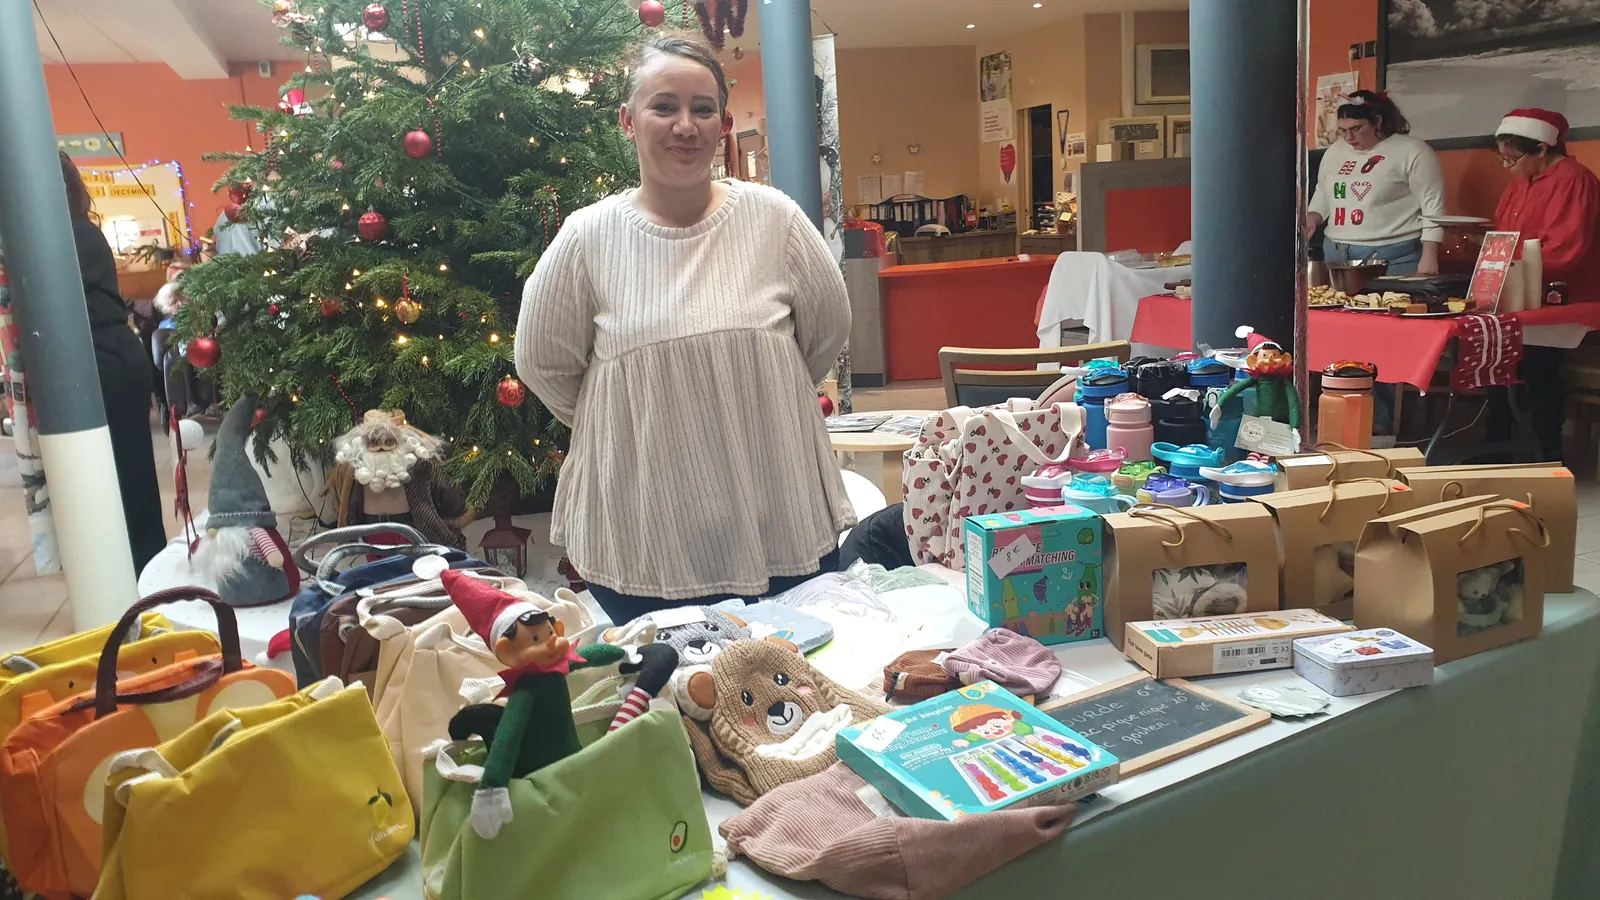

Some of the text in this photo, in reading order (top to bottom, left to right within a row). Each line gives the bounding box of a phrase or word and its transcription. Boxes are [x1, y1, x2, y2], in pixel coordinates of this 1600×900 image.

[1335, 207, 1364, 226] HO
[1025, 550, 1076, 567] MATCHING
[1079, 728, 1102, 738] ac
[1101, 713, 1139, 732] pique
